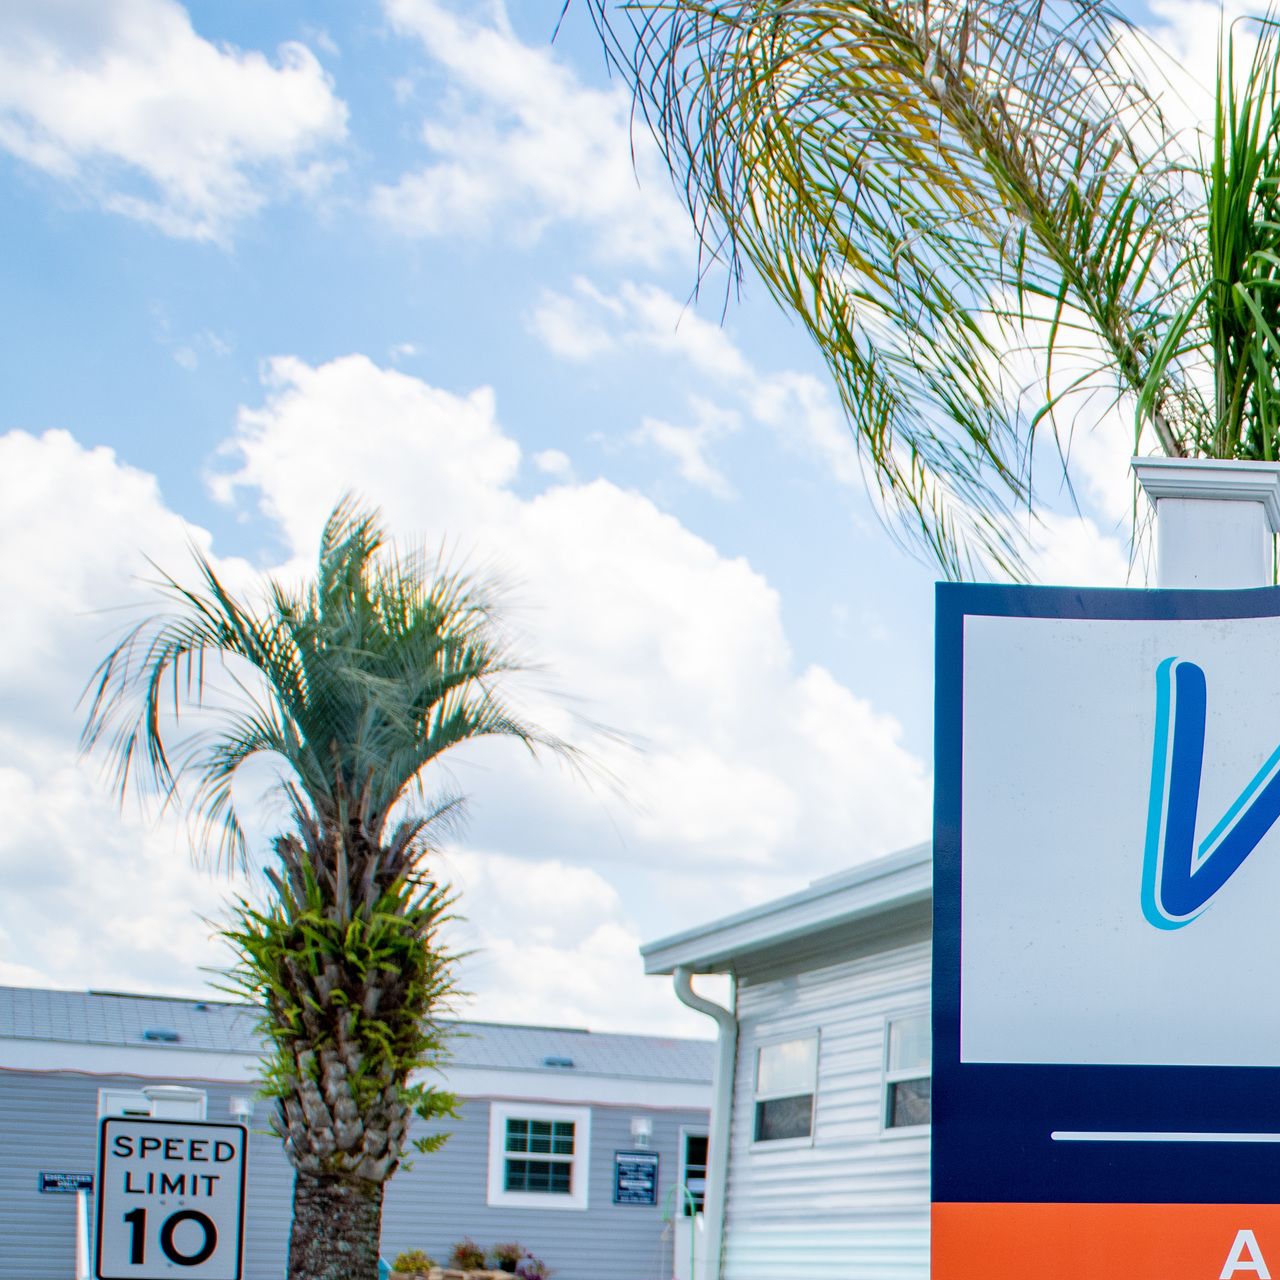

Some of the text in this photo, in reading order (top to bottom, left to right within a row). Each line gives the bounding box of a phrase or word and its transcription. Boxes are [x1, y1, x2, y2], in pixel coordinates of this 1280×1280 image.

[112, 1135, 236, 1163] SPEED
[124, 1171, 221, 1197] LIMIT
[124, 1208, 218, 1267] 10
